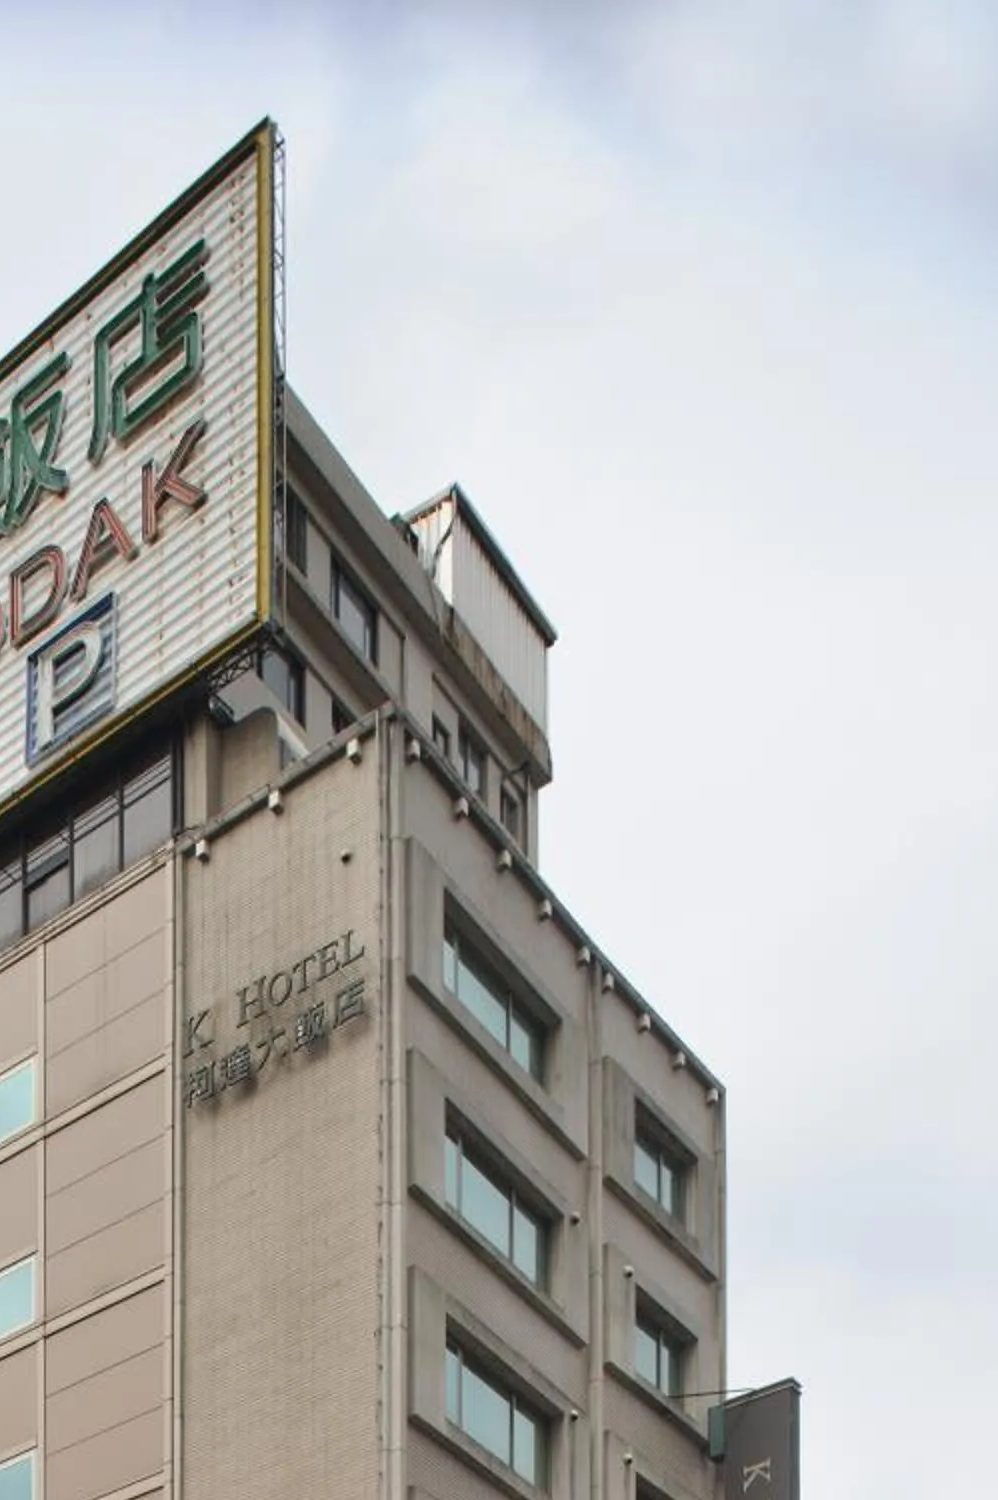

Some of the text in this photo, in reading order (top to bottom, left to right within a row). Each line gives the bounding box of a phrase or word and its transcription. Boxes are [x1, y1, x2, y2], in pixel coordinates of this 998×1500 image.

[183, 929, 365, 1059] K HOTEL
[743, 1457, 771, 1493] K
